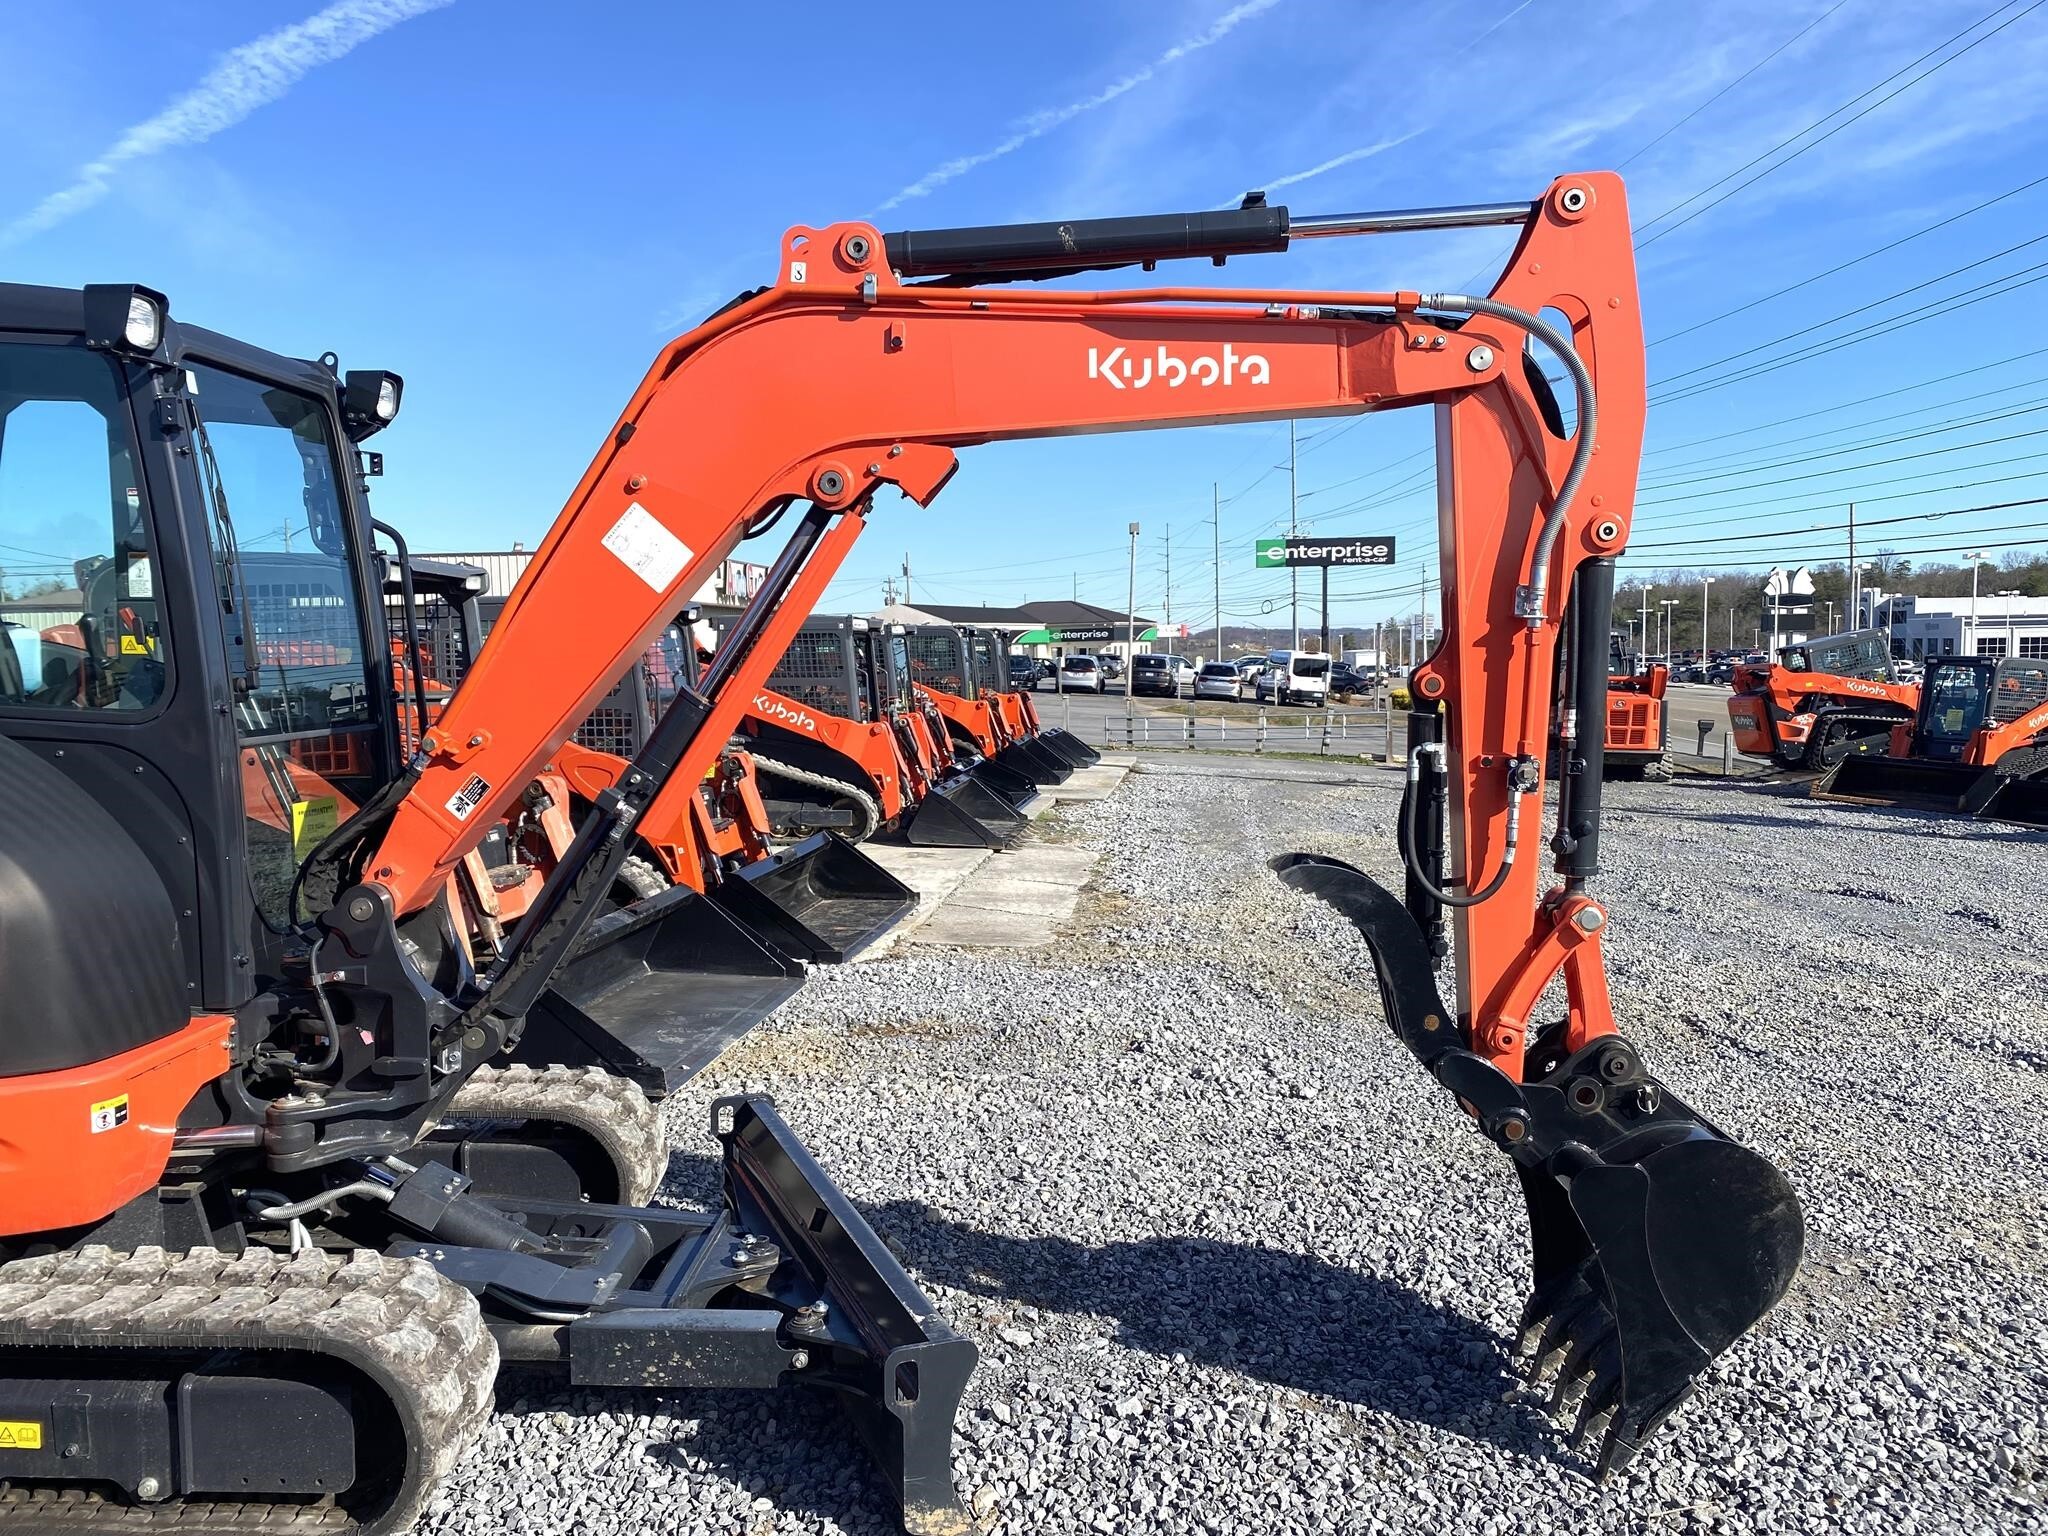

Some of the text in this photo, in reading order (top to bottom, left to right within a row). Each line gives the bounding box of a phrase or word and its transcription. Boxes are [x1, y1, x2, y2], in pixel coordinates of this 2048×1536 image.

[1088, 343, 1270, 389] Kubota
[1267, 542, 1388, 561] enterprise
[1052, 630, 1109, 641] enterprise
[1847, 680, 1886, 696] Kubota
[752, 693, 815, 731] Kubota
